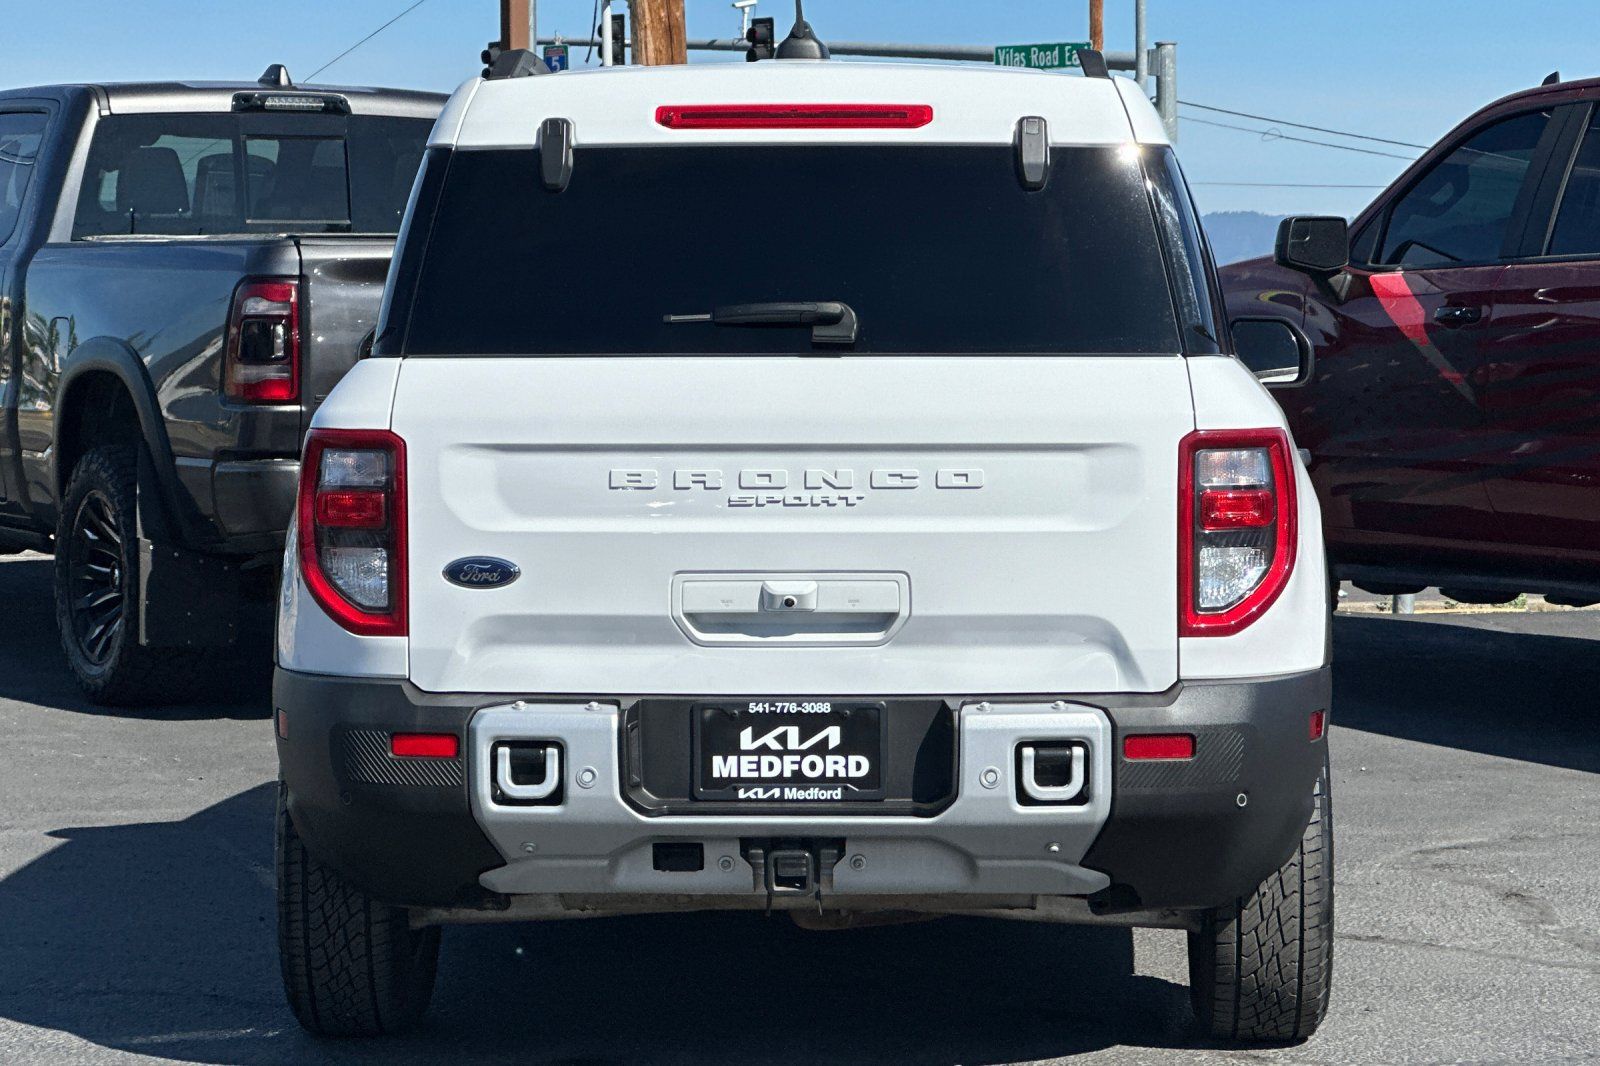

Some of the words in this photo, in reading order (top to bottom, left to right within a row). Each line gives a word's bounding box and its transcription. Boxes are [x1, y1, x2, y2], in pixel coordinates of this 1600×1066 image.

[551, 56, 561, 73] 5
[998, 47, 1026, 66] Vilas
[1031, 46, 1059, 66] Road
[608, 468, 985, 490] BRONCO
[727, 494, 865, 508] SPORT
[459, 563, 501, 582] Ford
[748, 702, 832, 714] 541-776-3088
[739, 725, 841, 751] KIA
[712, 755, 870, 778] MEDFORD
[738, 787, 780, 799] KIA
[784, 787, 842, 800] Medford
